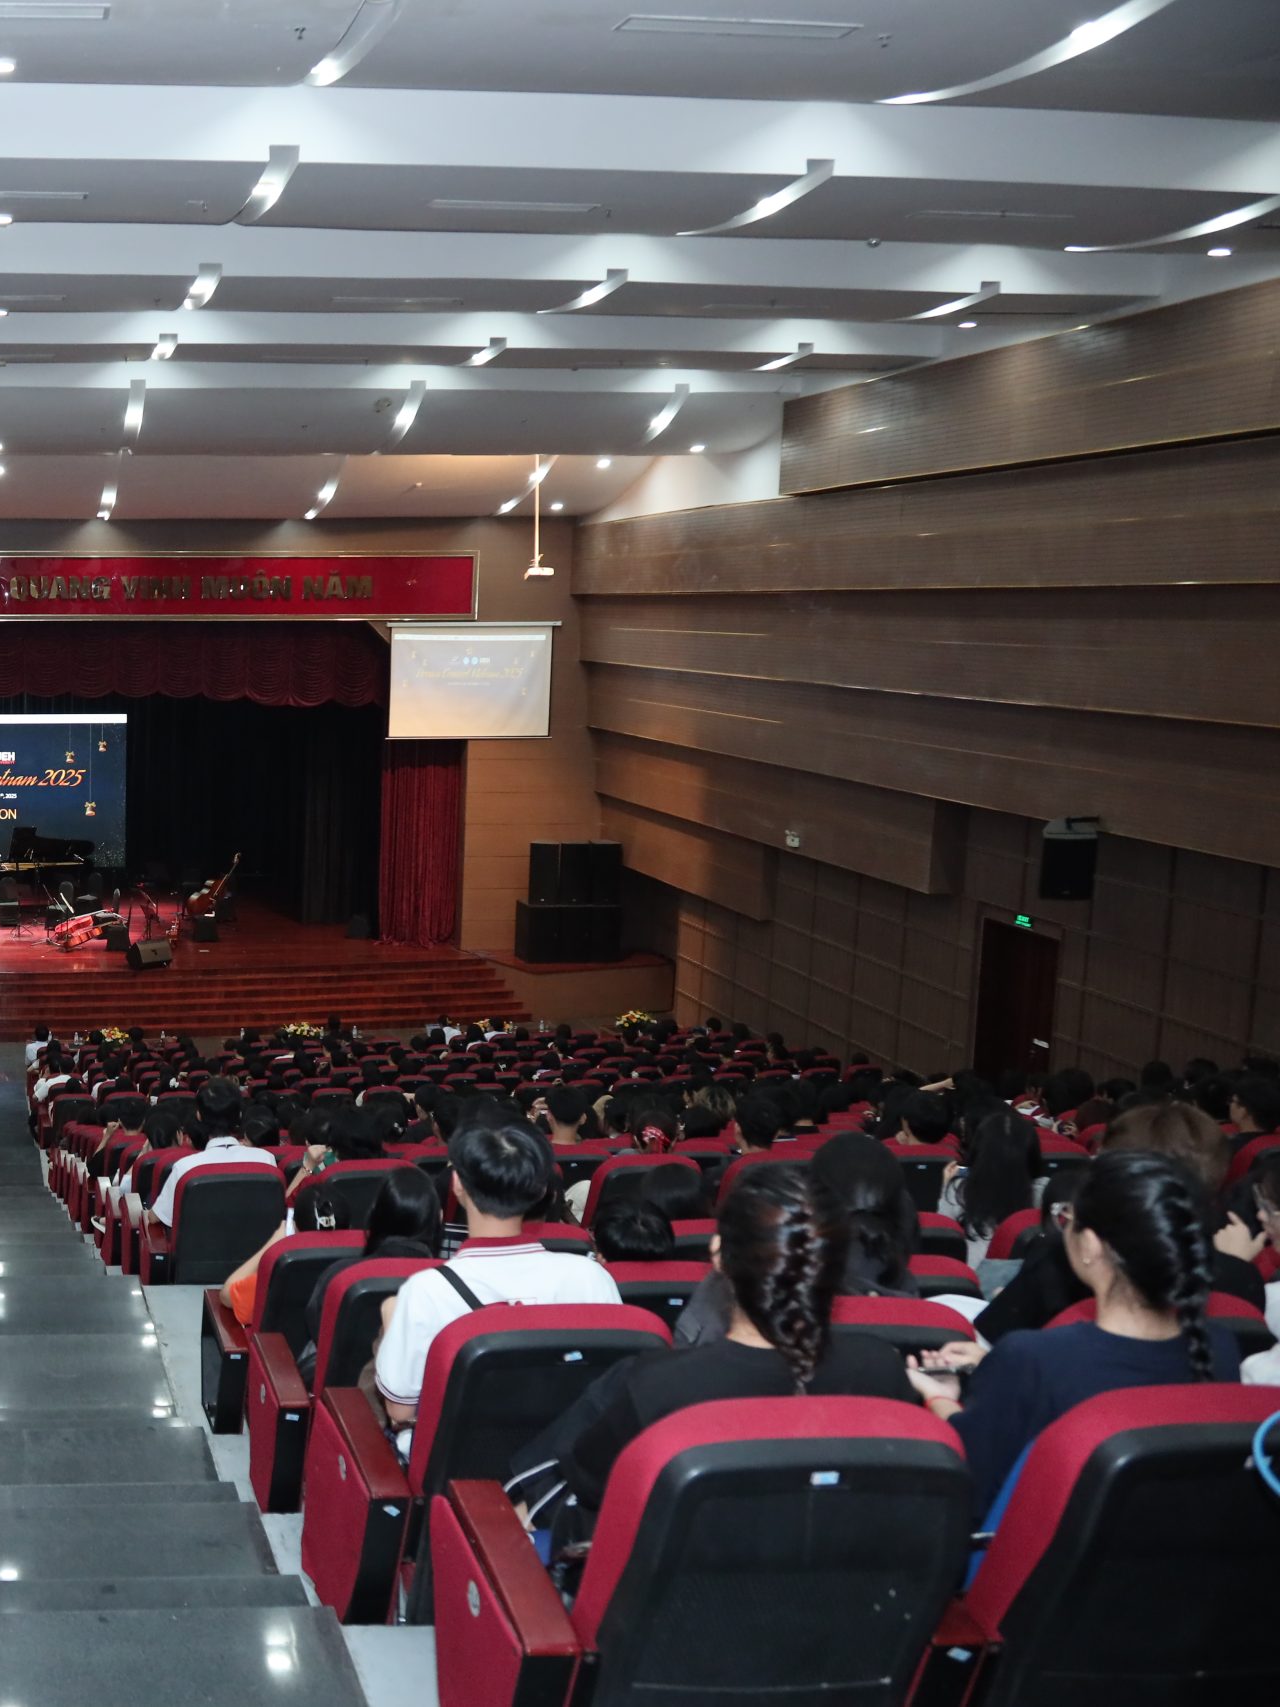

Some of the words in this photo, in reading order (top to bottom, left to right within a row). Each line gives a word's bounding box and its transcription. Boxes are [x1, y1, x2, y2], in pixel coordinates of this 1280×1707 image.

[9, 575, 111, 601] QUANG
[121, 575, 191, 600] VINH
[201, 569, 292, 601] MUÔN
[302, 569, 372, 601] NĂM
[37, 769, 87, 787] 2025
